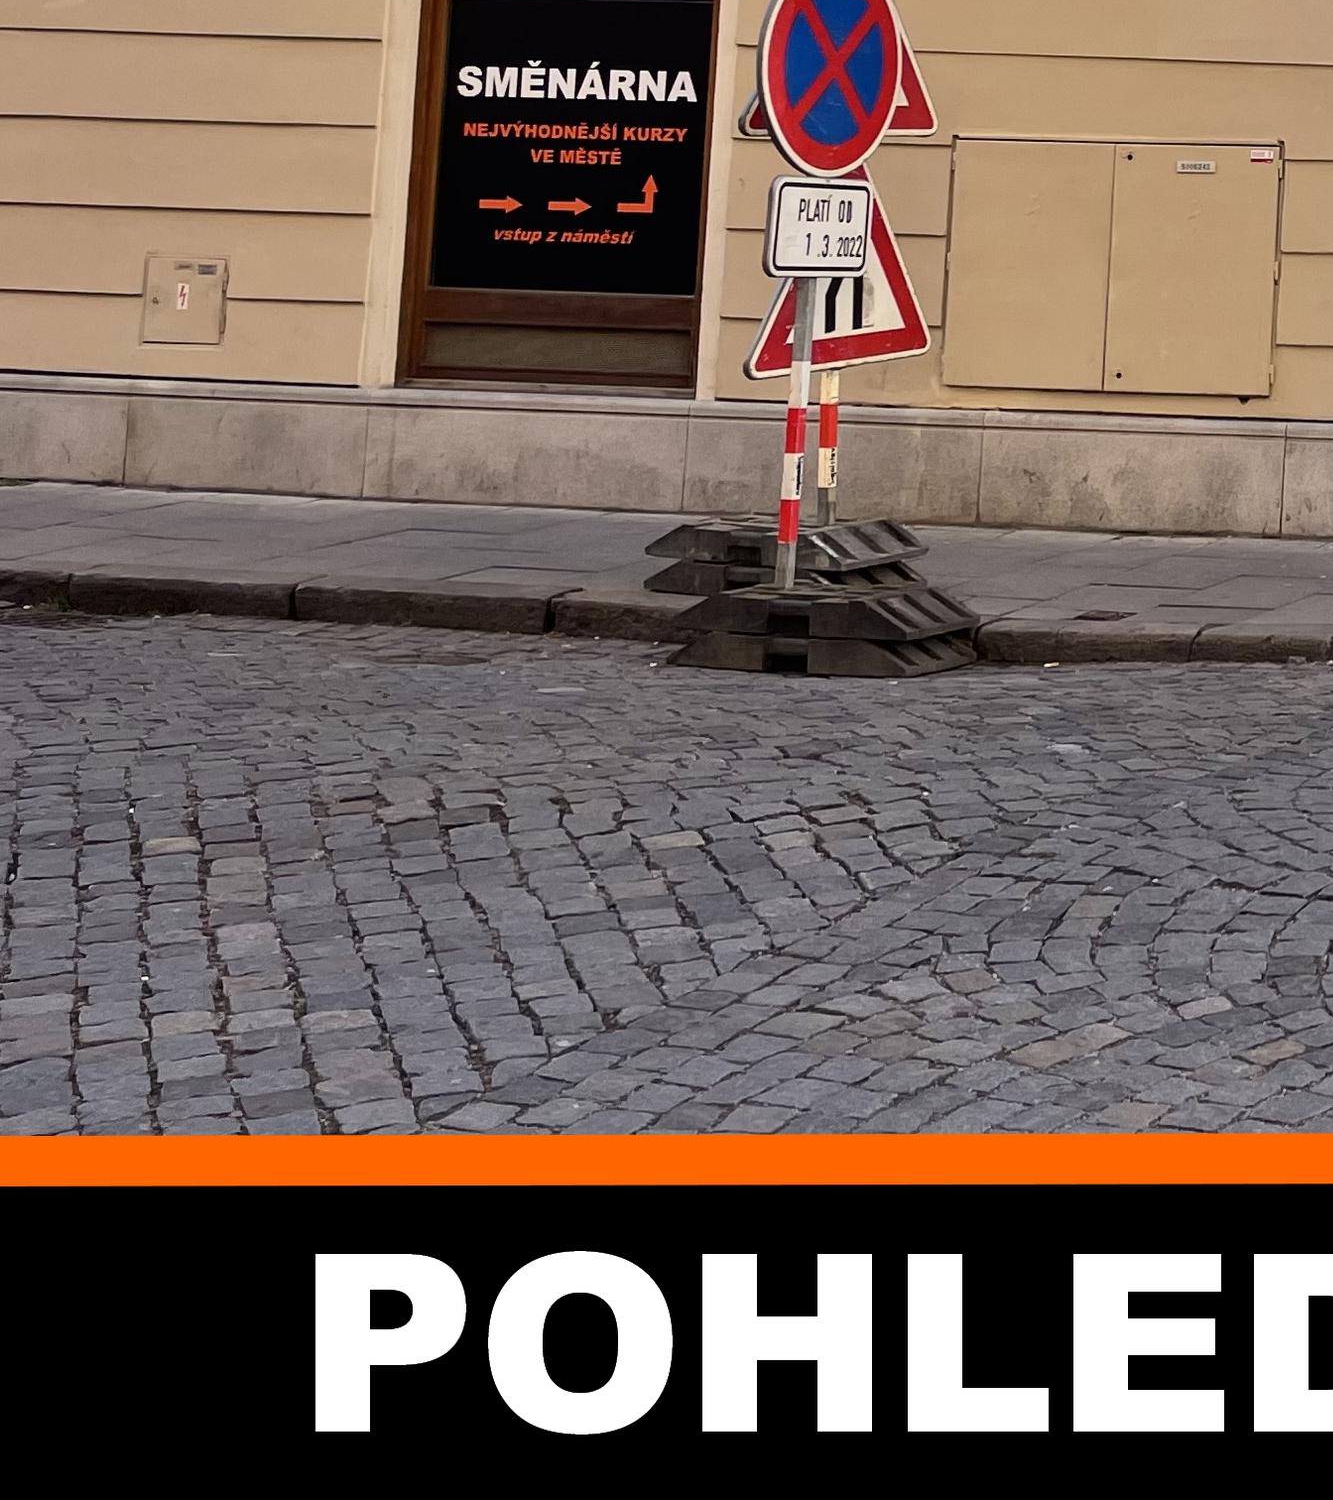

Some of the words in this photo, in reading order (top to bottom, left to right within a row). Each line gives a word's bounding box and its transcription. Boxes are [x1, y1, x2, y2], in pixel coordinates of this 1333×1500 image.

[456, 59, 698, 103] SMĚNÁRNA
[463, 120, 618, 142] NEJVÝHODNĚJŠÍ
[623, 127, 689, 143] KURZY
[530, 148, 554, 164] VE
[559, 147, 623, 166] MĚSTĚ
[797, 194, 833, 222] PLATÍ
[838, 199, 853, 224] OD
[494, 227, 543, 245] vstup
[545, 231, 556, 243] z
[560, 228, 635, 245] náměstí
[836, 234, 864, 258] 2022
